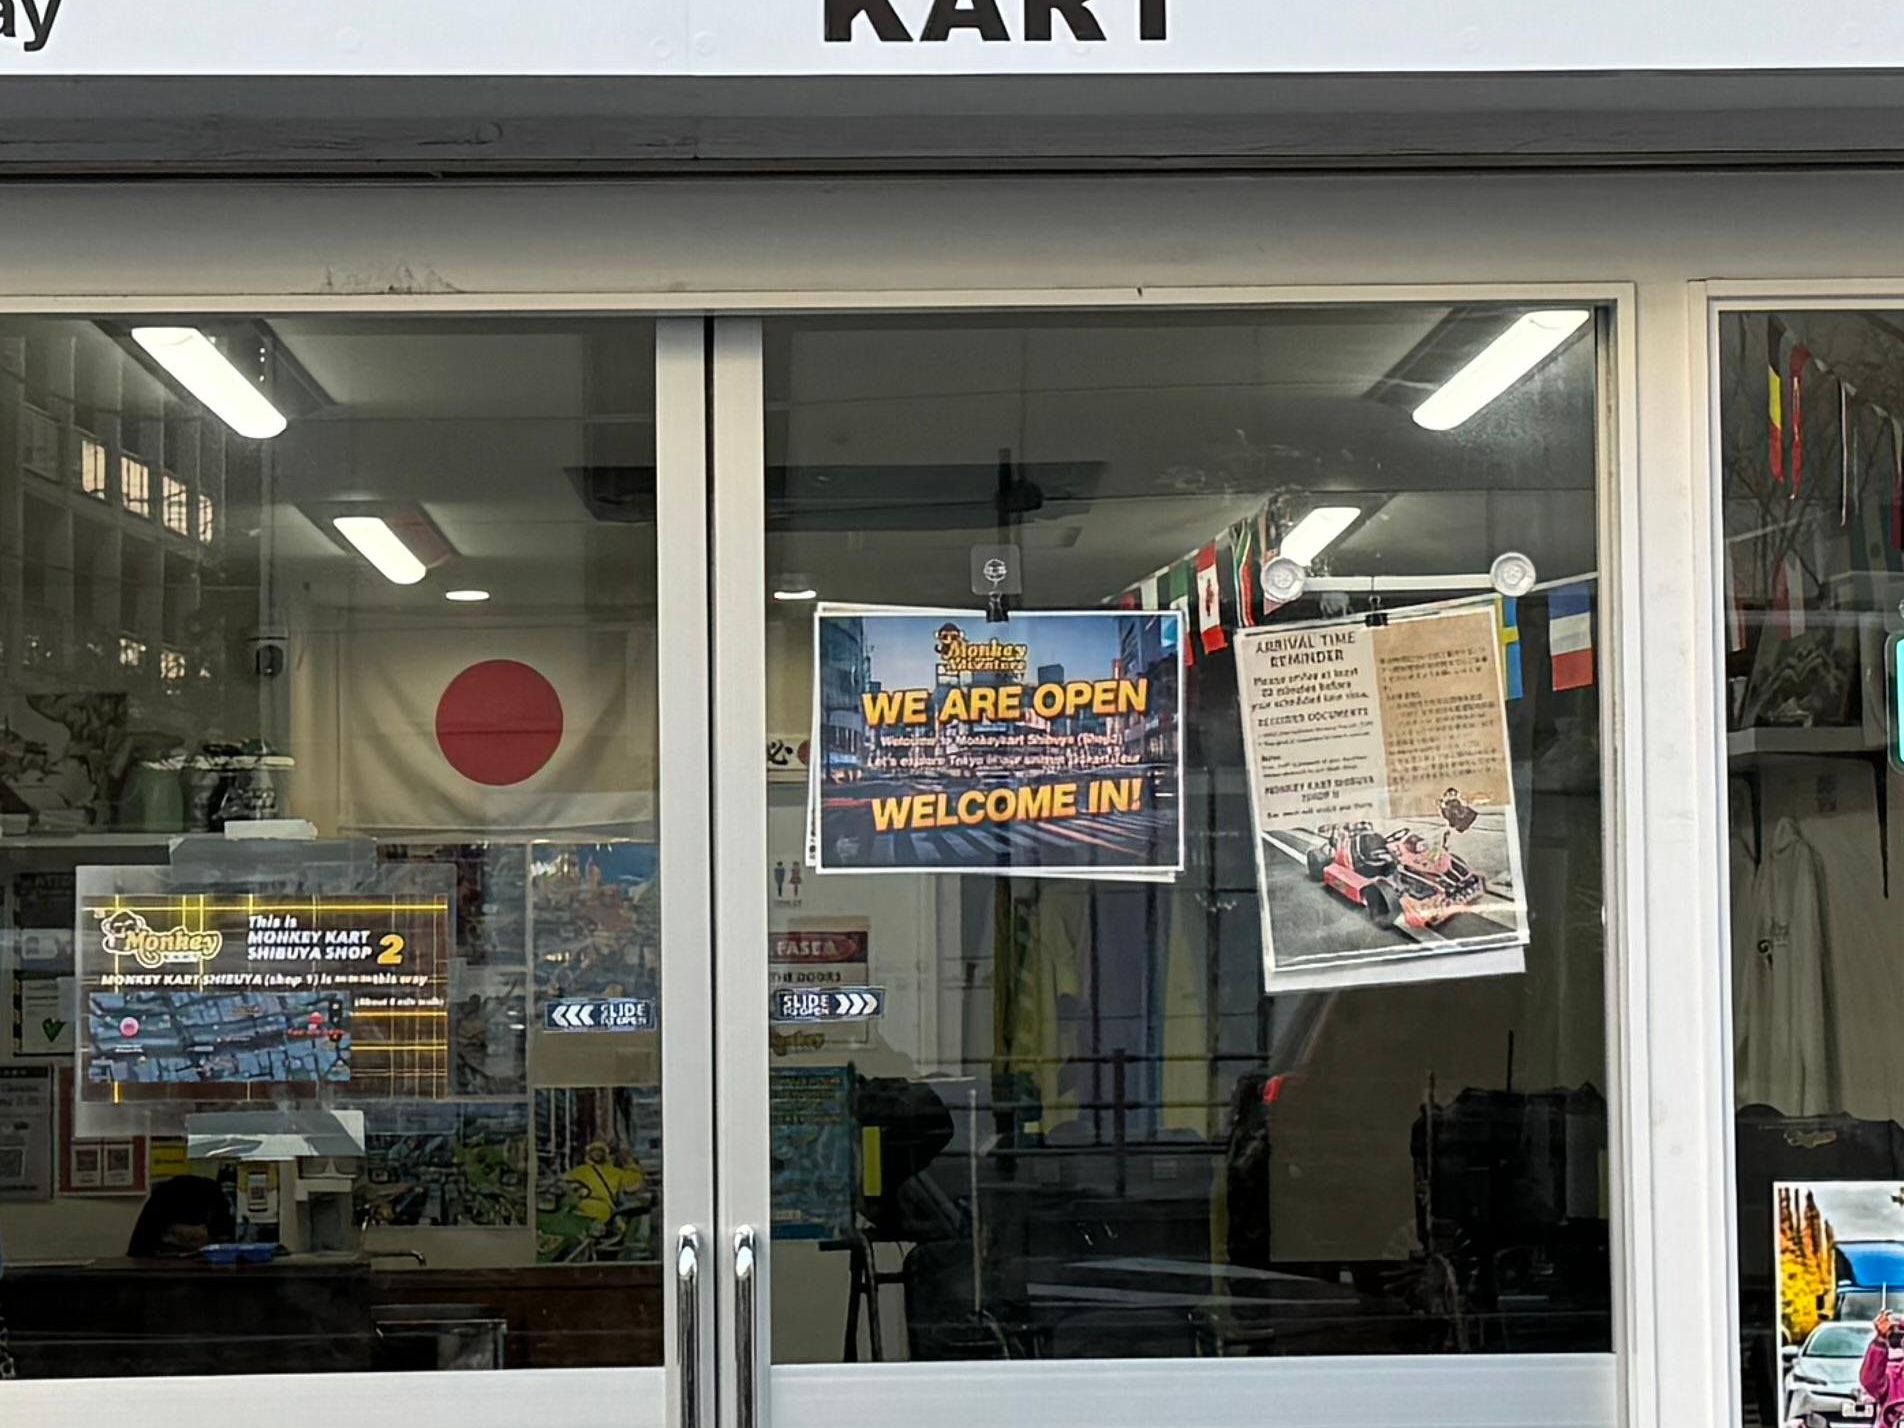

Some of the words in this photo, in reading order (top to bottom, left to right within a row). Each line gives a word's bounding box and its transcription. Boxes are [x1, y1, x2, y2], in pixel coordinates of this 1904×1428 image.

[947, 639, 1027, 660] Monkey
[1256, 636, 1315, 654] ARRIVAL
[1322, 631, 1356, 646] TIME
[1270, 650, 1344, 667] REMINDER
[862, 690, 930, 726] WE
[939, 686, 1023, 722] ARE
[1033, 678, 1148, 717] OPEN
[872, 783, 1078, 831] WELCOME
[1088, 778, 1143, 814] IN!
[247, 915, 281, 929] This
[284, 916, 297, 929] is
[124, 928, 221, 964] Monkey
[247, 930, 323, 944] MONKEY
[326, 930, 370, 944] KART
[247, 946, 322, 960] SHIBUYA
[325, 946, 373, 960] SHOP
[377, 934, 405, 965] 2
[101, 974, 161, 986] MONKEY
[163, 974, 198, 986] KART
[201, 974, 262, 986] SHIBUYA
[601, 1002, 646, 1017] SLIDE
[783, 994, 830, 1009] SLIDE
